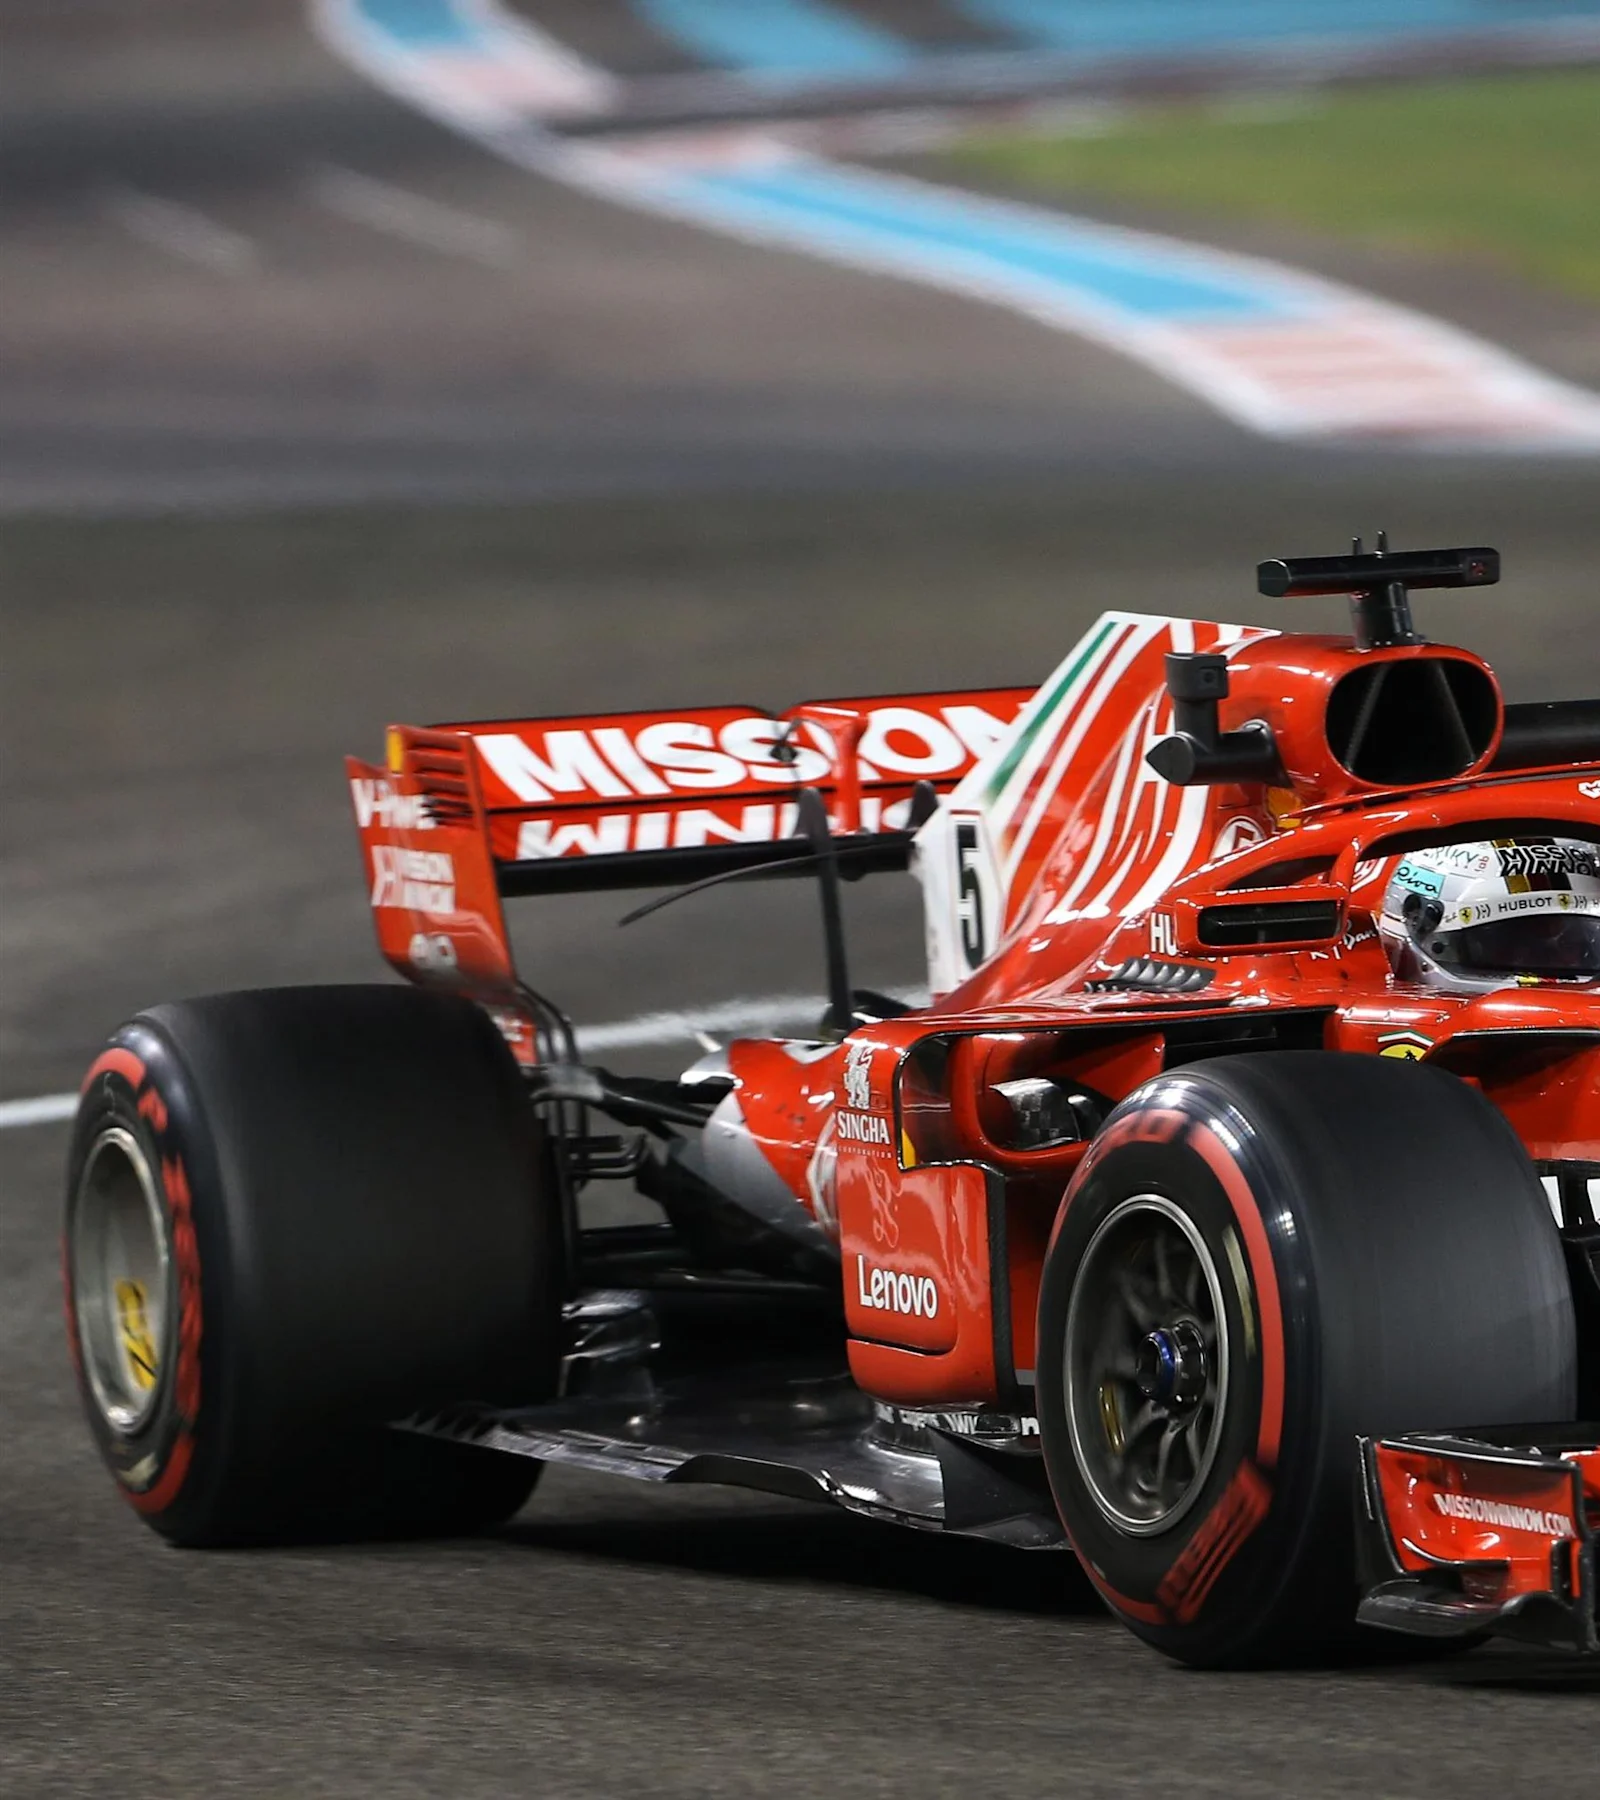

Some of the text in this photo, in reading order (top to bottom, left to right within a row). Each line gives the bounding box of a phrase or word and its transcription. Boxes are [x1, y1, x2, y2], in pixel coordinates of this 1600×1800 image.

[956, 822, 986, 970] 5
[1497, 896, 1553, 912] HUBLOT
[837, 1110, 890, 1144] SINGHA
[857, 1254, 937, 1319] Lenovo
